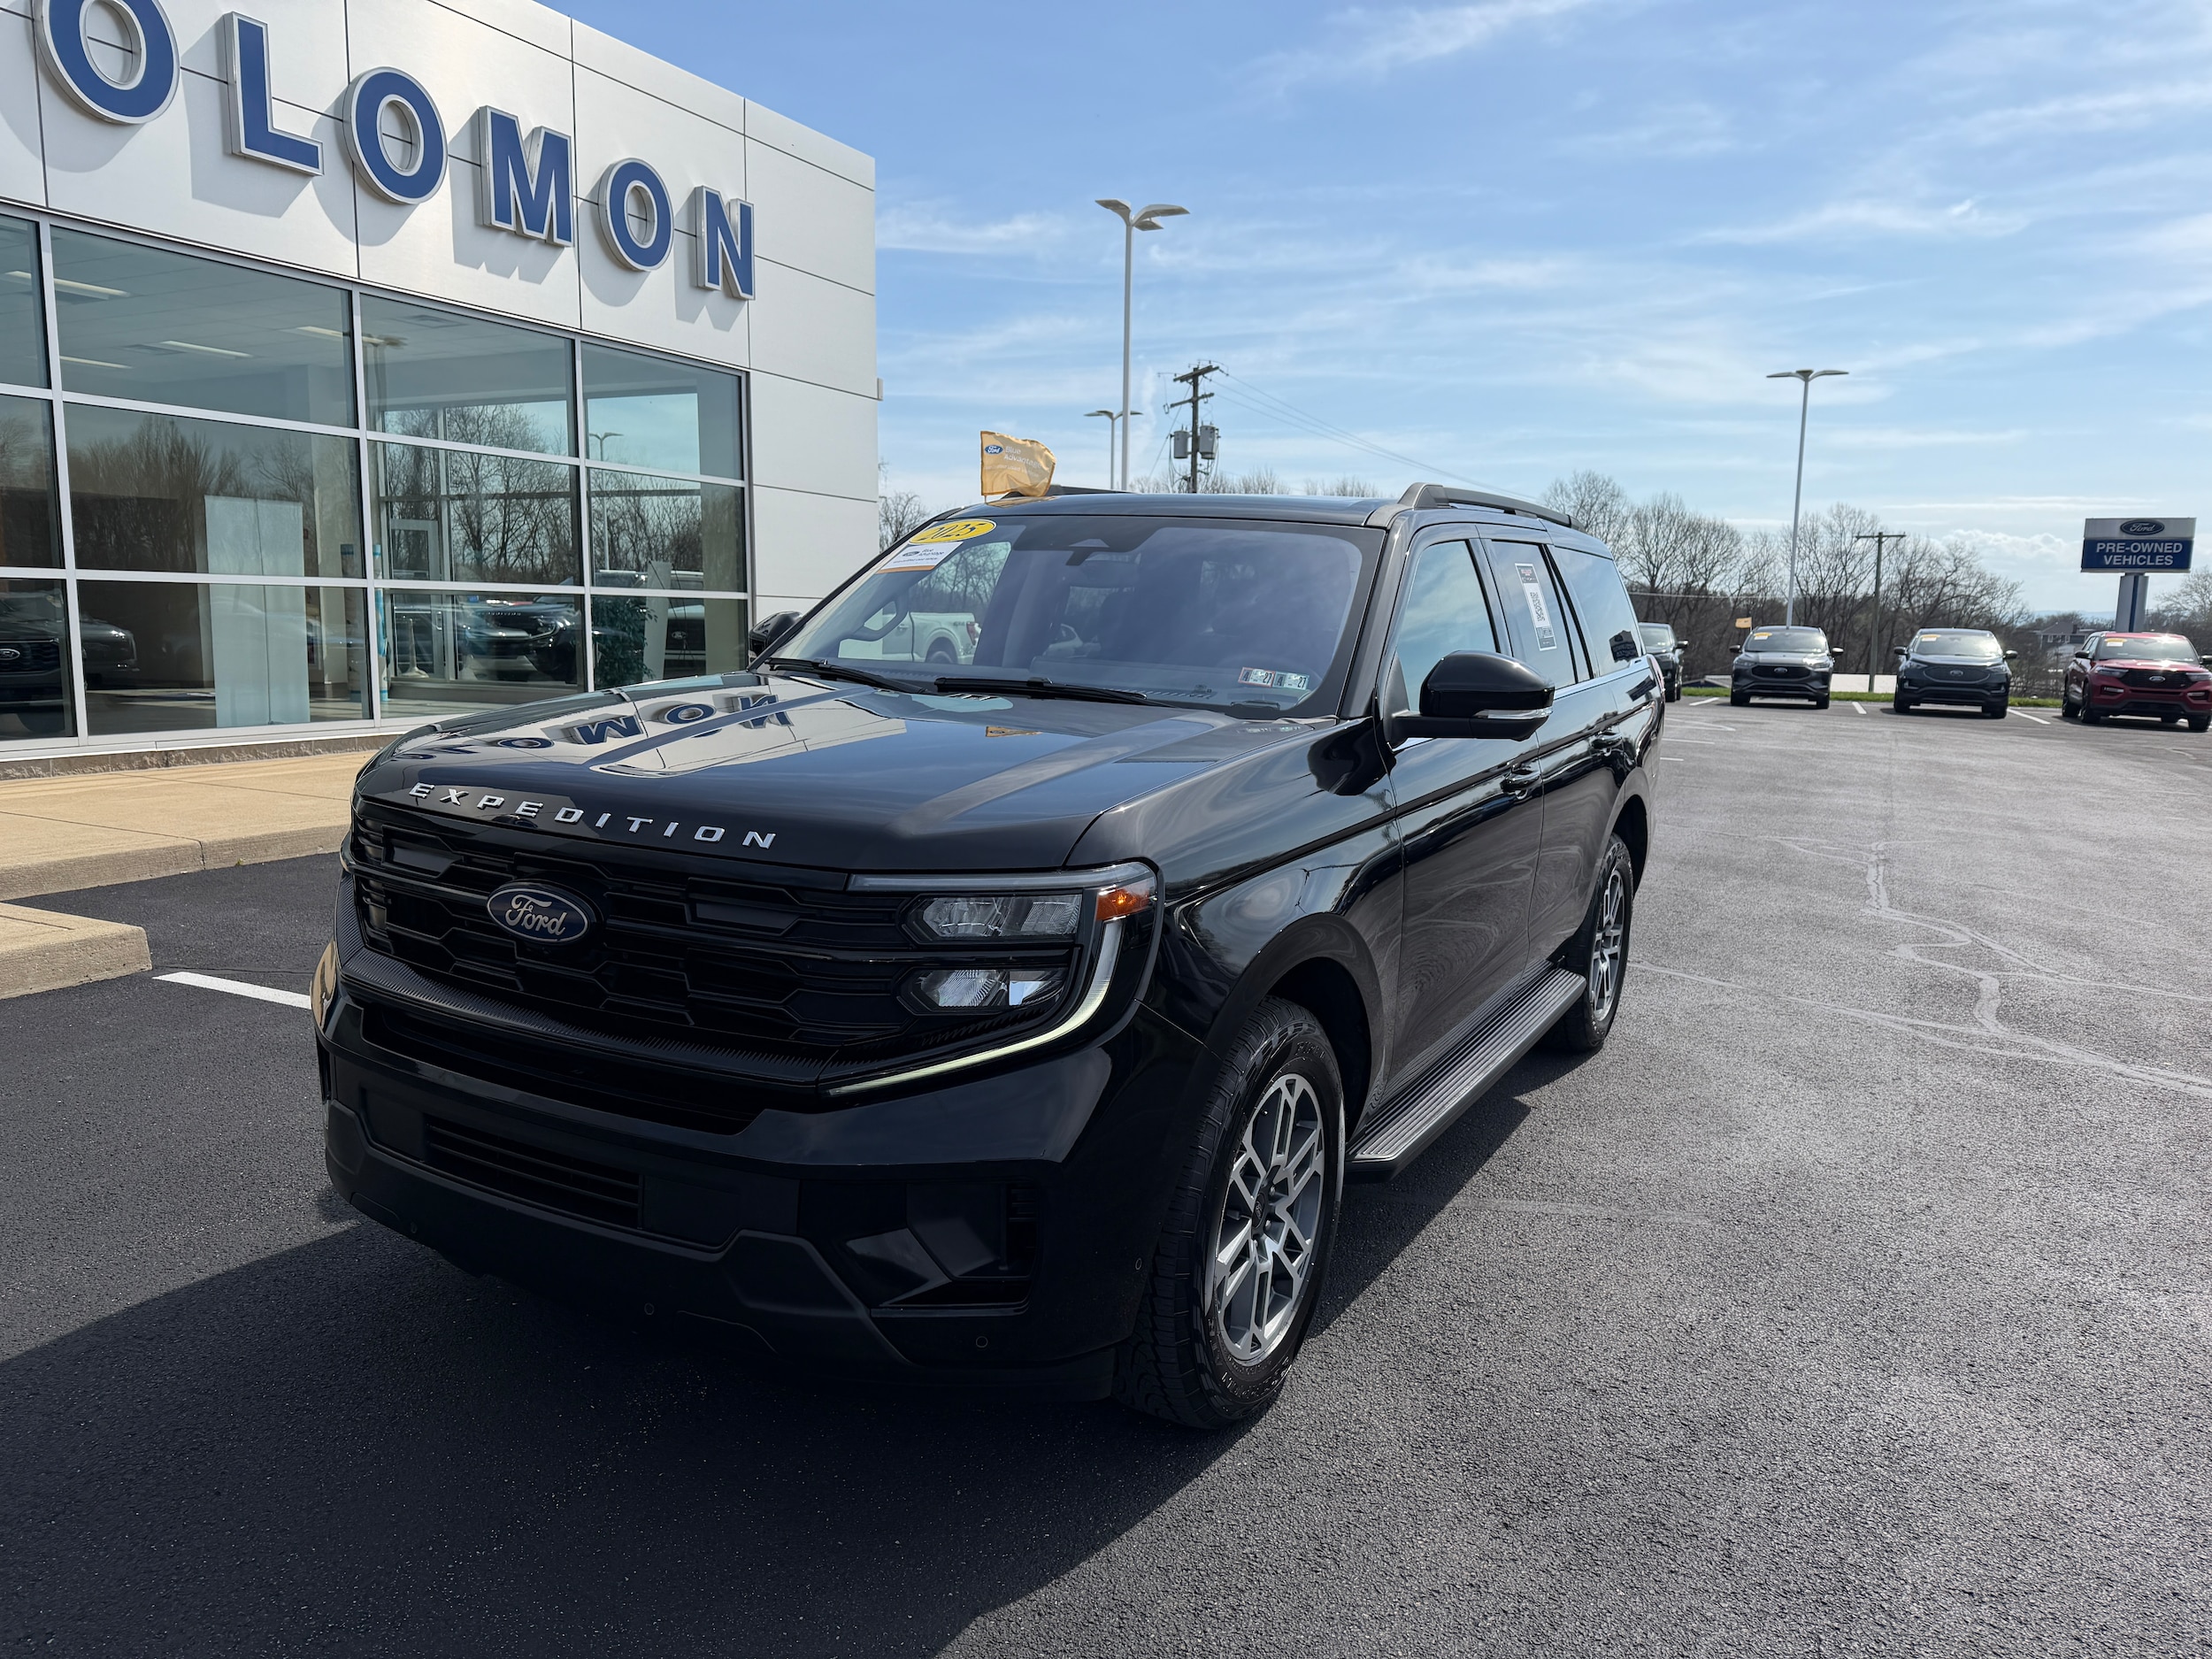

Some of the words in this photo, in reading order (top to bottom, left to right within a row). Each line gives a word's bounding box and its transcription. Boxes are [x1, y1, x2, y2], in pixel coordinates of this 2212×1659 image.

[1005, 446, 1021, 455] Blue
[916, 521, 987, 541] 2025
[2130, 523, 2156, 532] Ford
[2096, 542, 2183, 553] PRE-OWNED
[2104, 555, 2174, 565] VEHICLES
[1242, 671, 1250, 681] 4
[1263, 672, 1272, 684] 27
[1277, 676, 1284, 687] 4
[1297, 676, 1307, 688] 27
[409, 781, 776, 849] EXPEDITION
[505, 894, 567, 936] Ford
